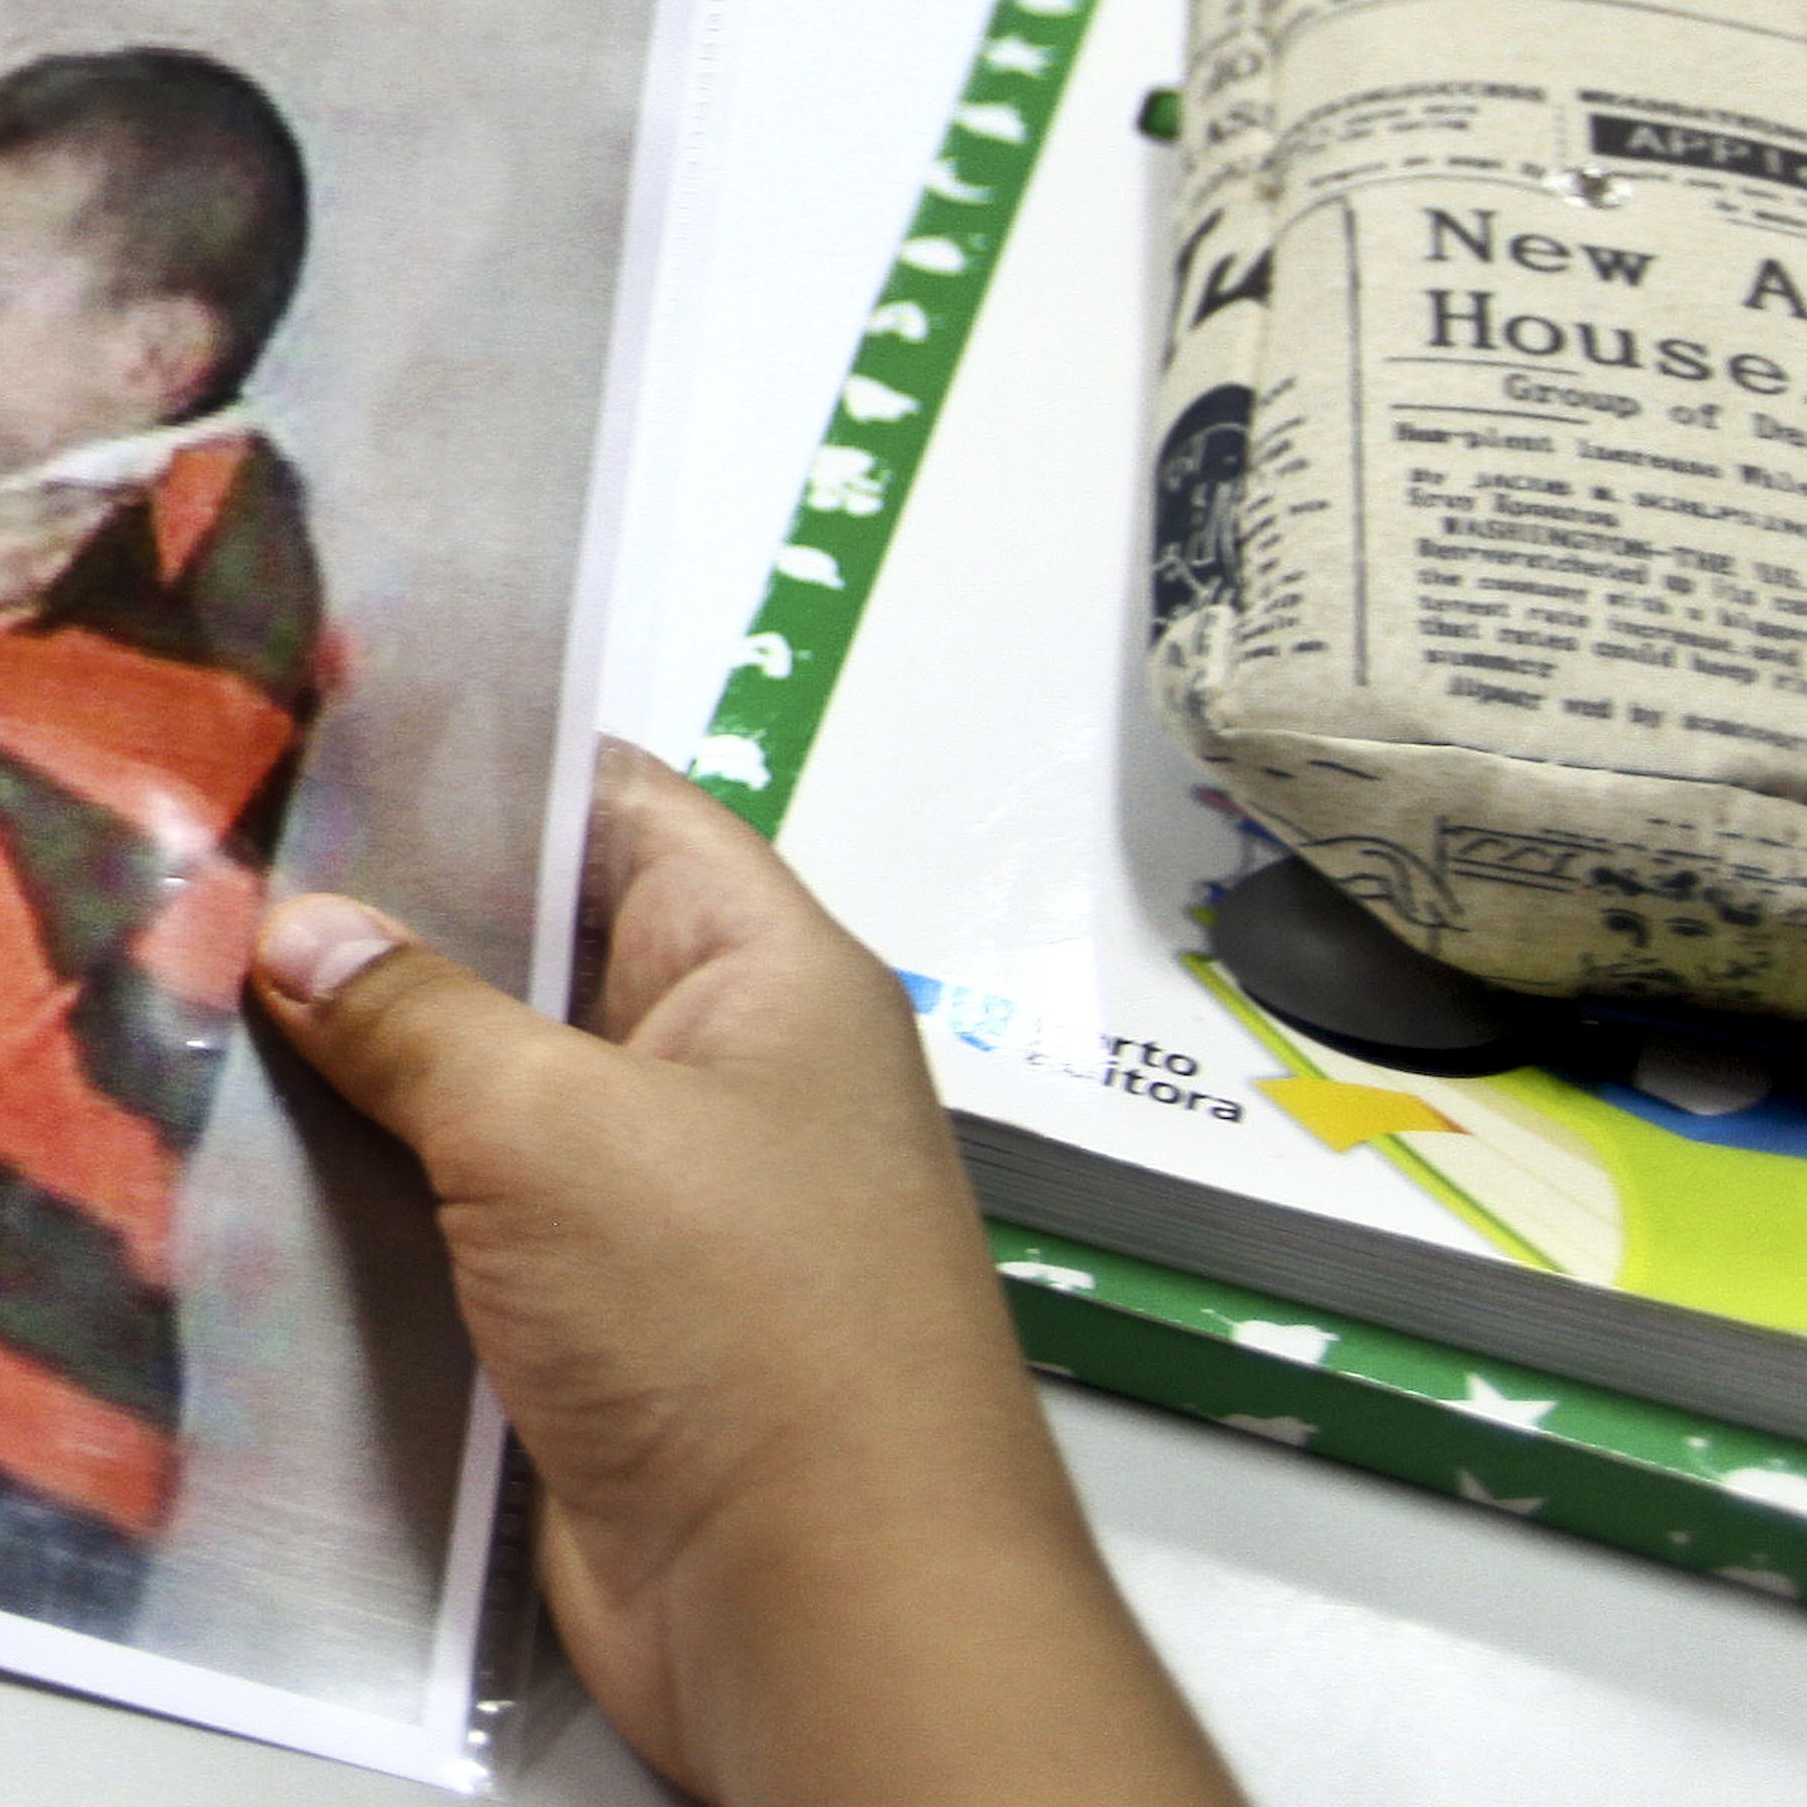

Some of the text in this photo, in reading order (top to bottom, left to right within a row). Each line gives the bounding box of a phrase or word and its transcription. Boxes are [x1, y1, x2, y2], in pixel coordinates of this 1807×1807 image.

[1423, 207, 1658, 287] New
[1424, 289, 1790, 395] House
[1504, 373, 1641, 416] Group
[1668, 403, 1722, 430] of
[1029, 1053, 1244, 1122] itora
